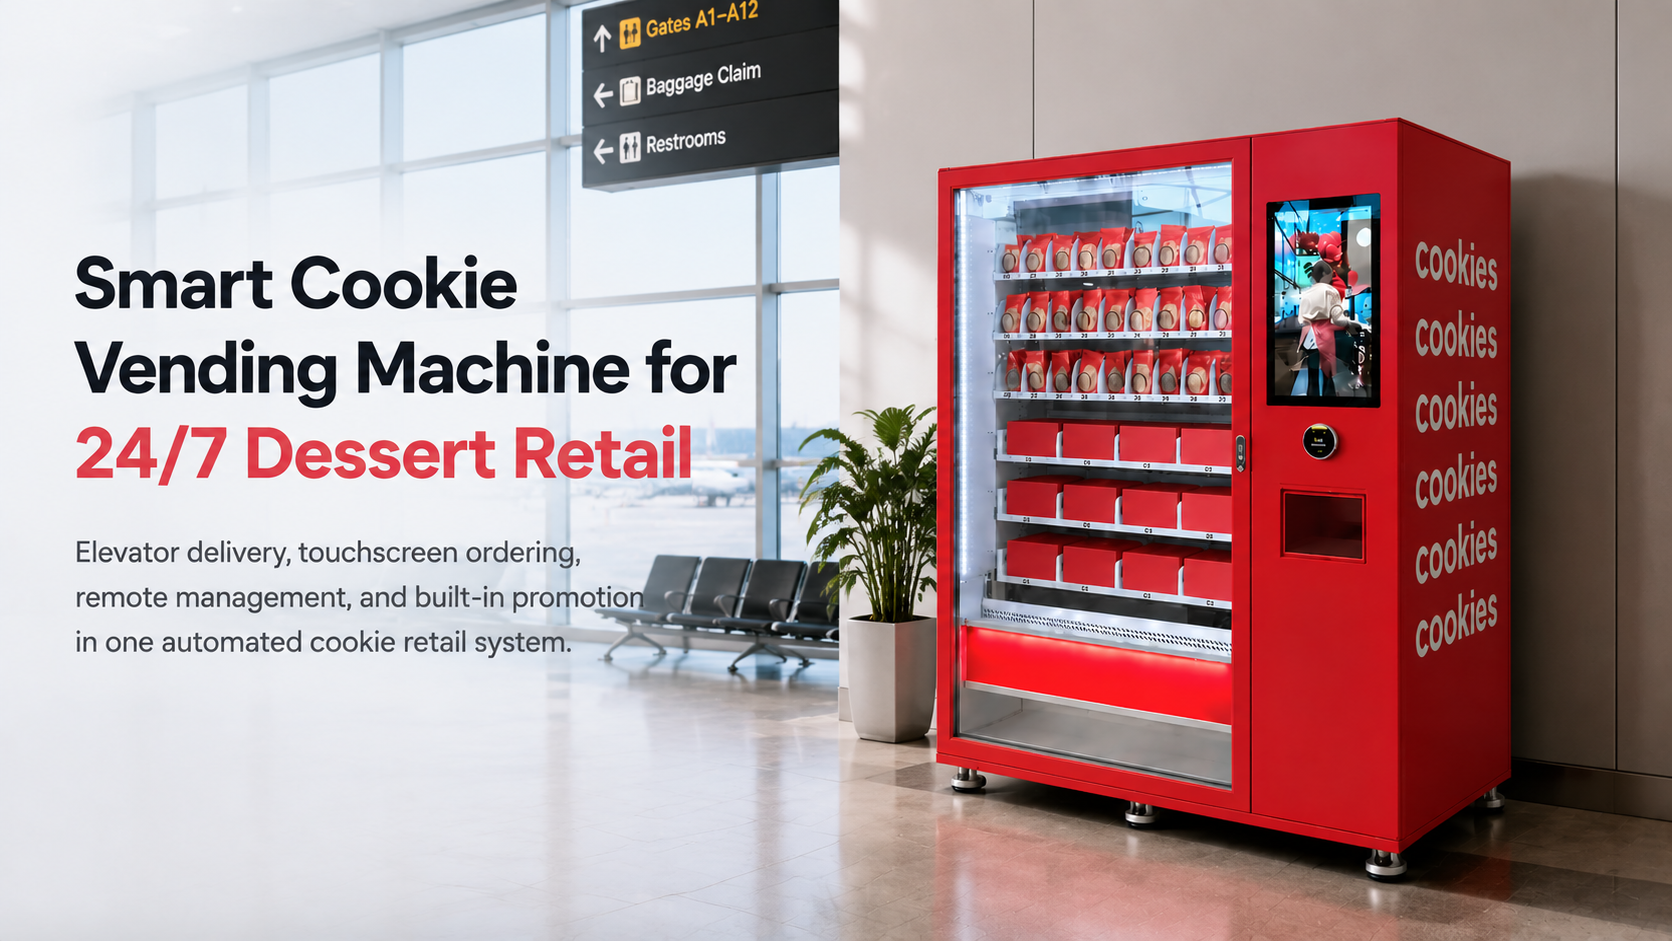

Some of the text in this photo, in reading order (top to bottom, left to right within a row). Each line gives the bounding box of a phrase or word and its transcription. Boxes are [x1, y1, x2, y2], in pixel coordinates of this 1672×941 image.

[646, 17, 691, 38] Gates
[646, 62, 761, 97] Baggage Claim
[646, 130, 726, 153] Restrooms
[1415, 309, 1498, 359] cookies
[1415, 380, 1498, 433] cookies
[1415, 451, 1498, 509] cookies
[1415, 520, 1498, 585] cookies
[1415, 589, 1498, 658] cookies
